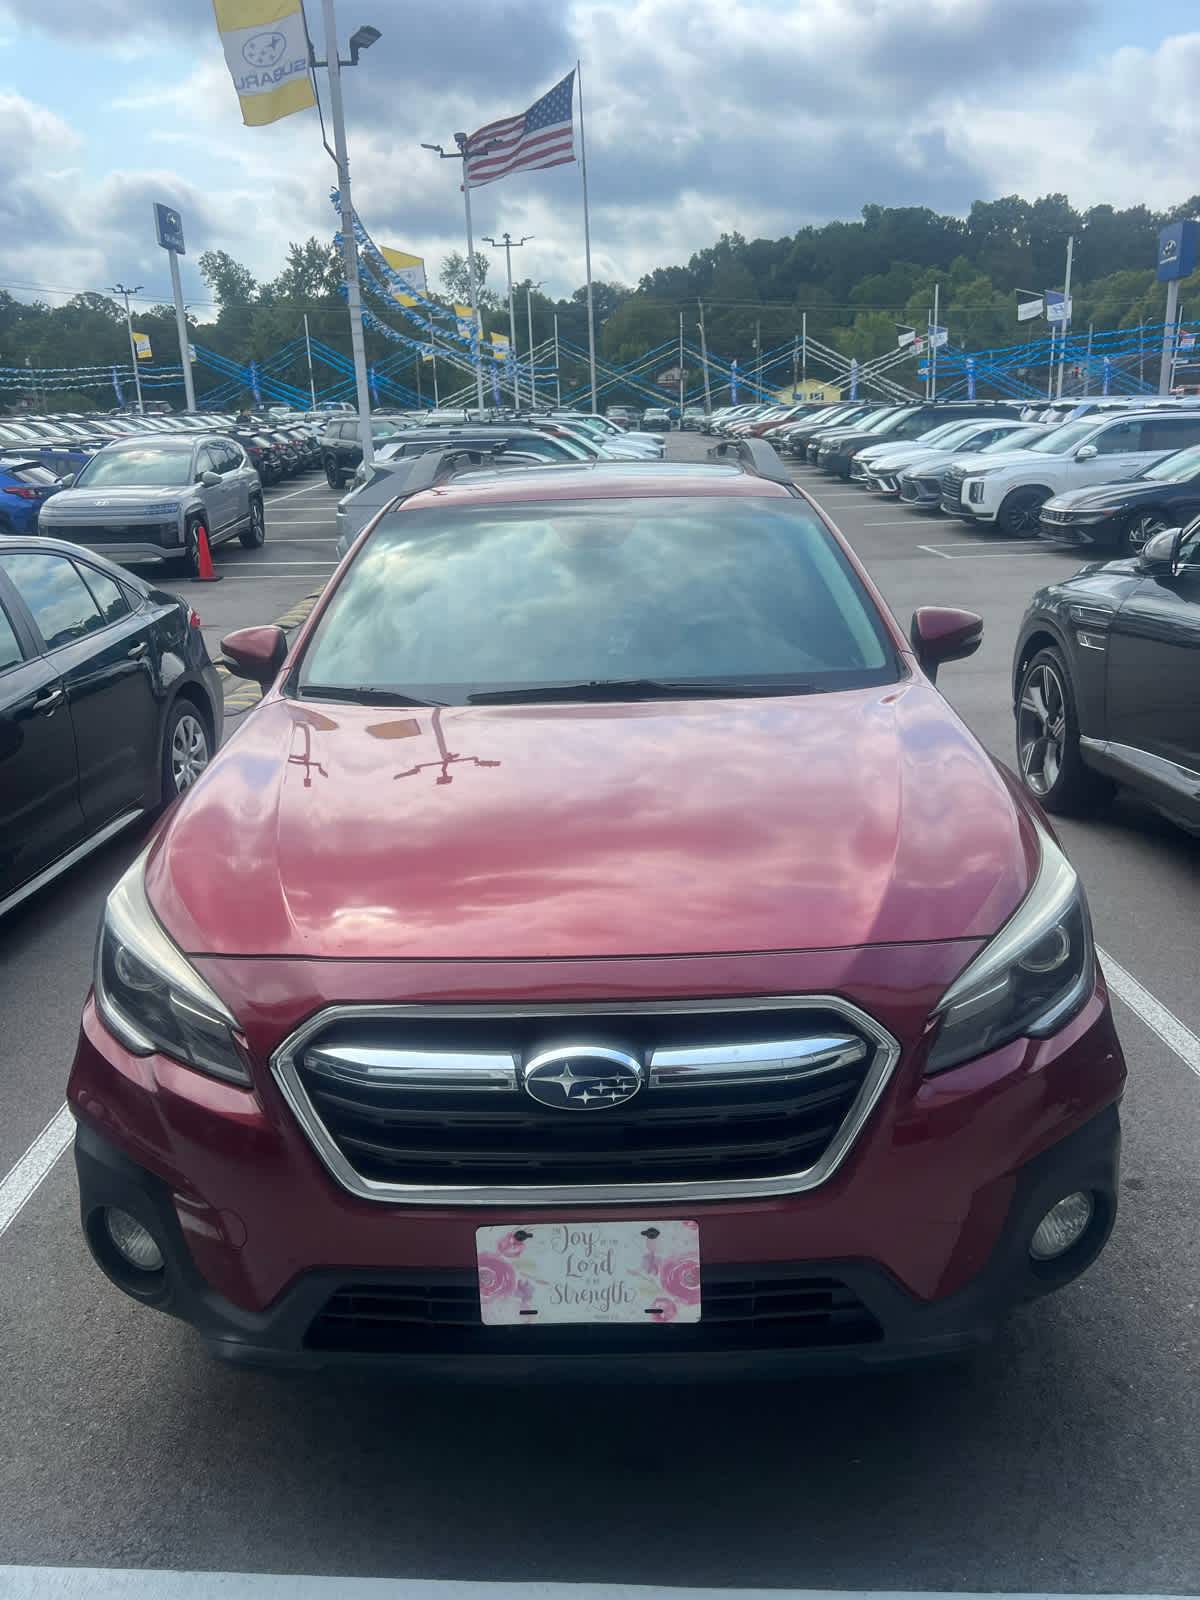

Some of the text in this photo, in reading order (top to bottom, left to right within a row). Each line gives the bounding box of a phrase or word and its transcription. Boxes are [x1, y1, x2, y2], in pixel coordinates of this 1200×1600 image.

[553, 1225, 600, 1257] Joy
[566, 1248, 614, 1278] Lord
[551, 1280, 635, 1312] Strength
